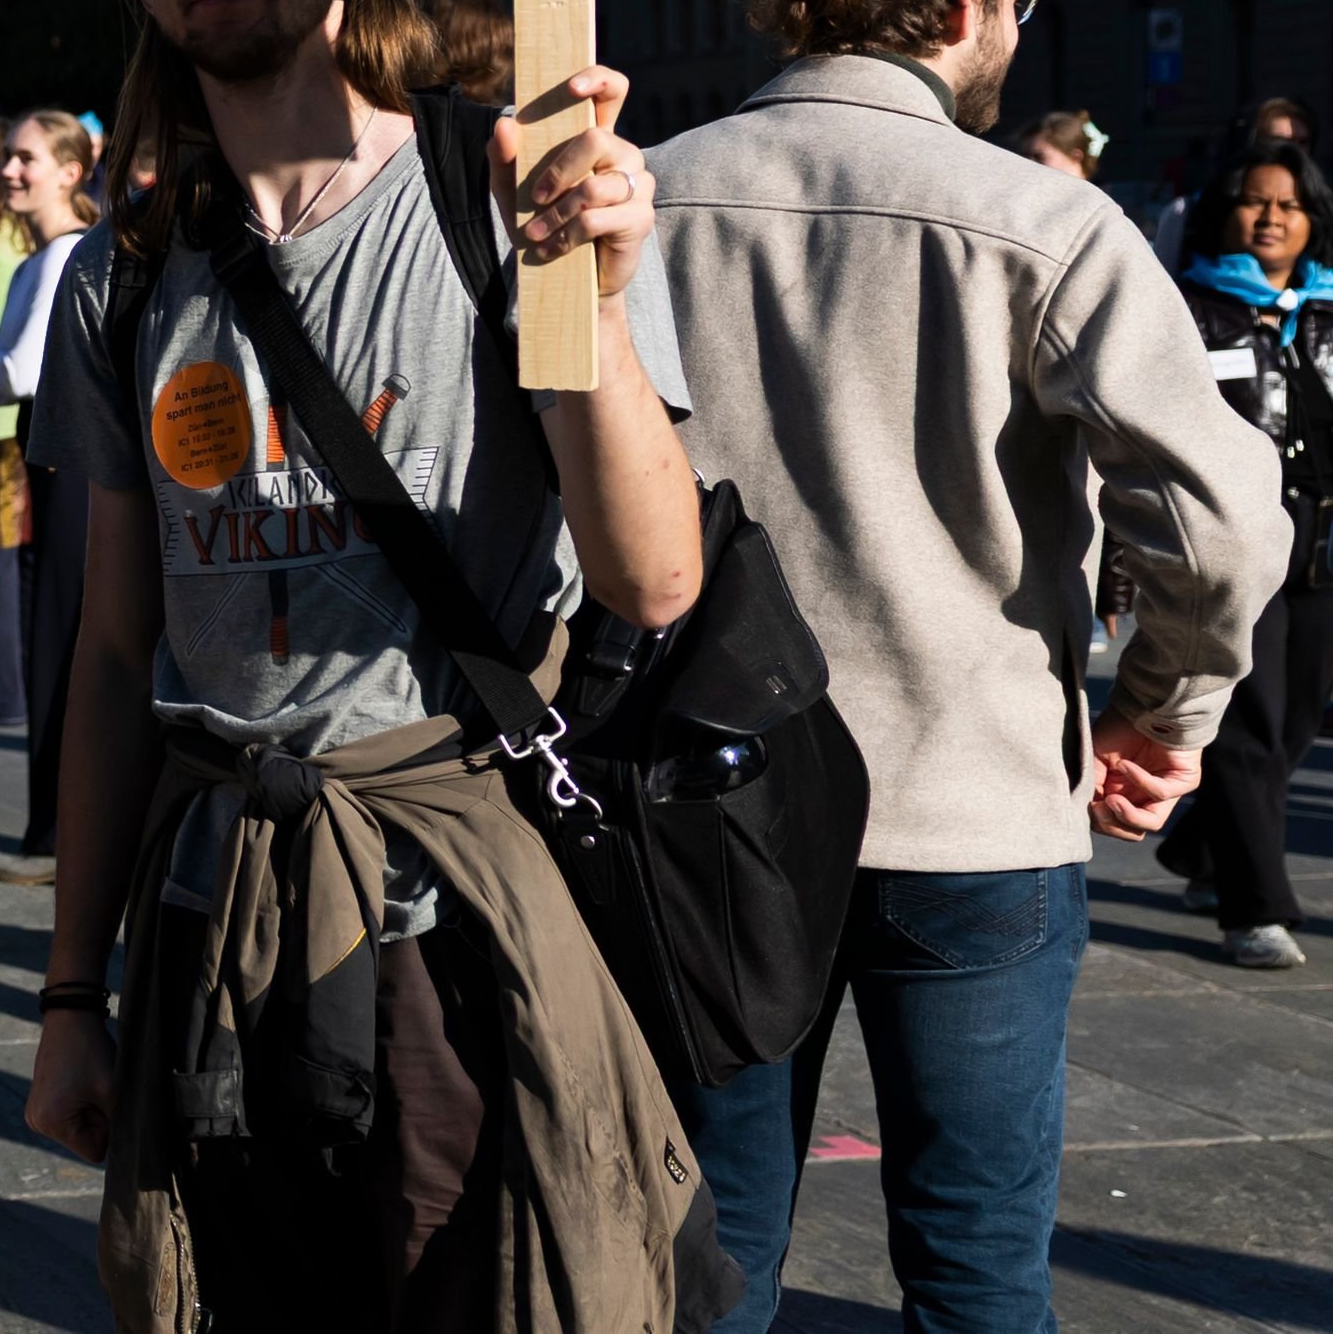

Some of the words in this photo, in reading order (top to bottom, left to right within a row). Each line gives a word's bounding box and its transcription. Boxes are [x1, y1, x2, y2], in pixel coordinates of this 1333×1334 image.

[174, 391, 189, 403] An
[190, 381, 229, 398] Bildung
[165, 405, 193, 422] spart
[194, 401, 216, 413] man
[217, 393, 242, 407] nicht
